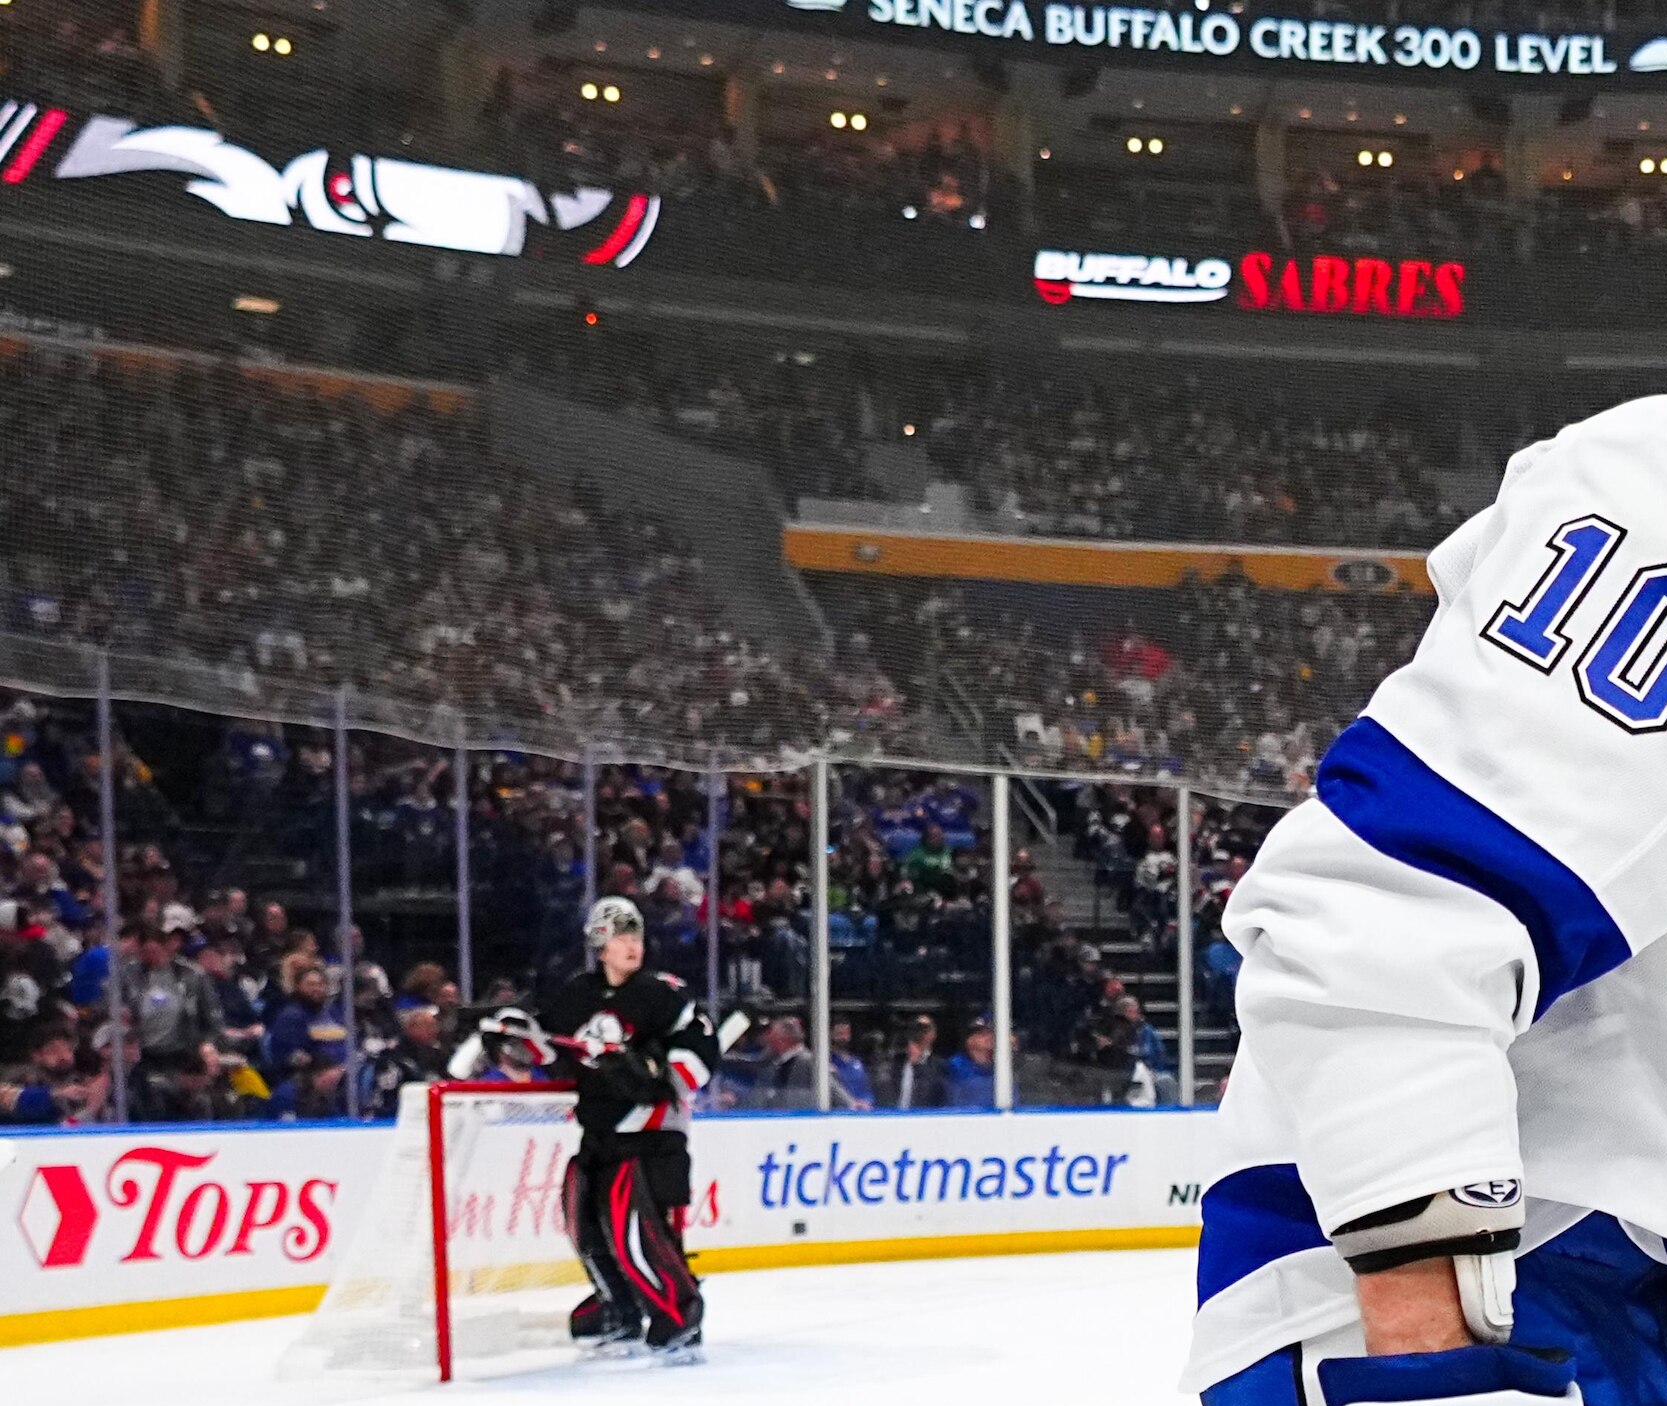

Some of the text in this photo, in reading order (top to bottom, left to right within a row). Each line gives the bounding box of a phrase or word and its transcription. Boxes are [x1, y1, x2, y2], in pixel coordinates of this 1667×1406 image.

[868, 0, 1618, 74] SENECA BUFFALO CREEK 300 LEVEL
[1034, 250, 1465, 318] BUFFALO SABRES
[757, 1141, 1130, 1209] ticketmaster
